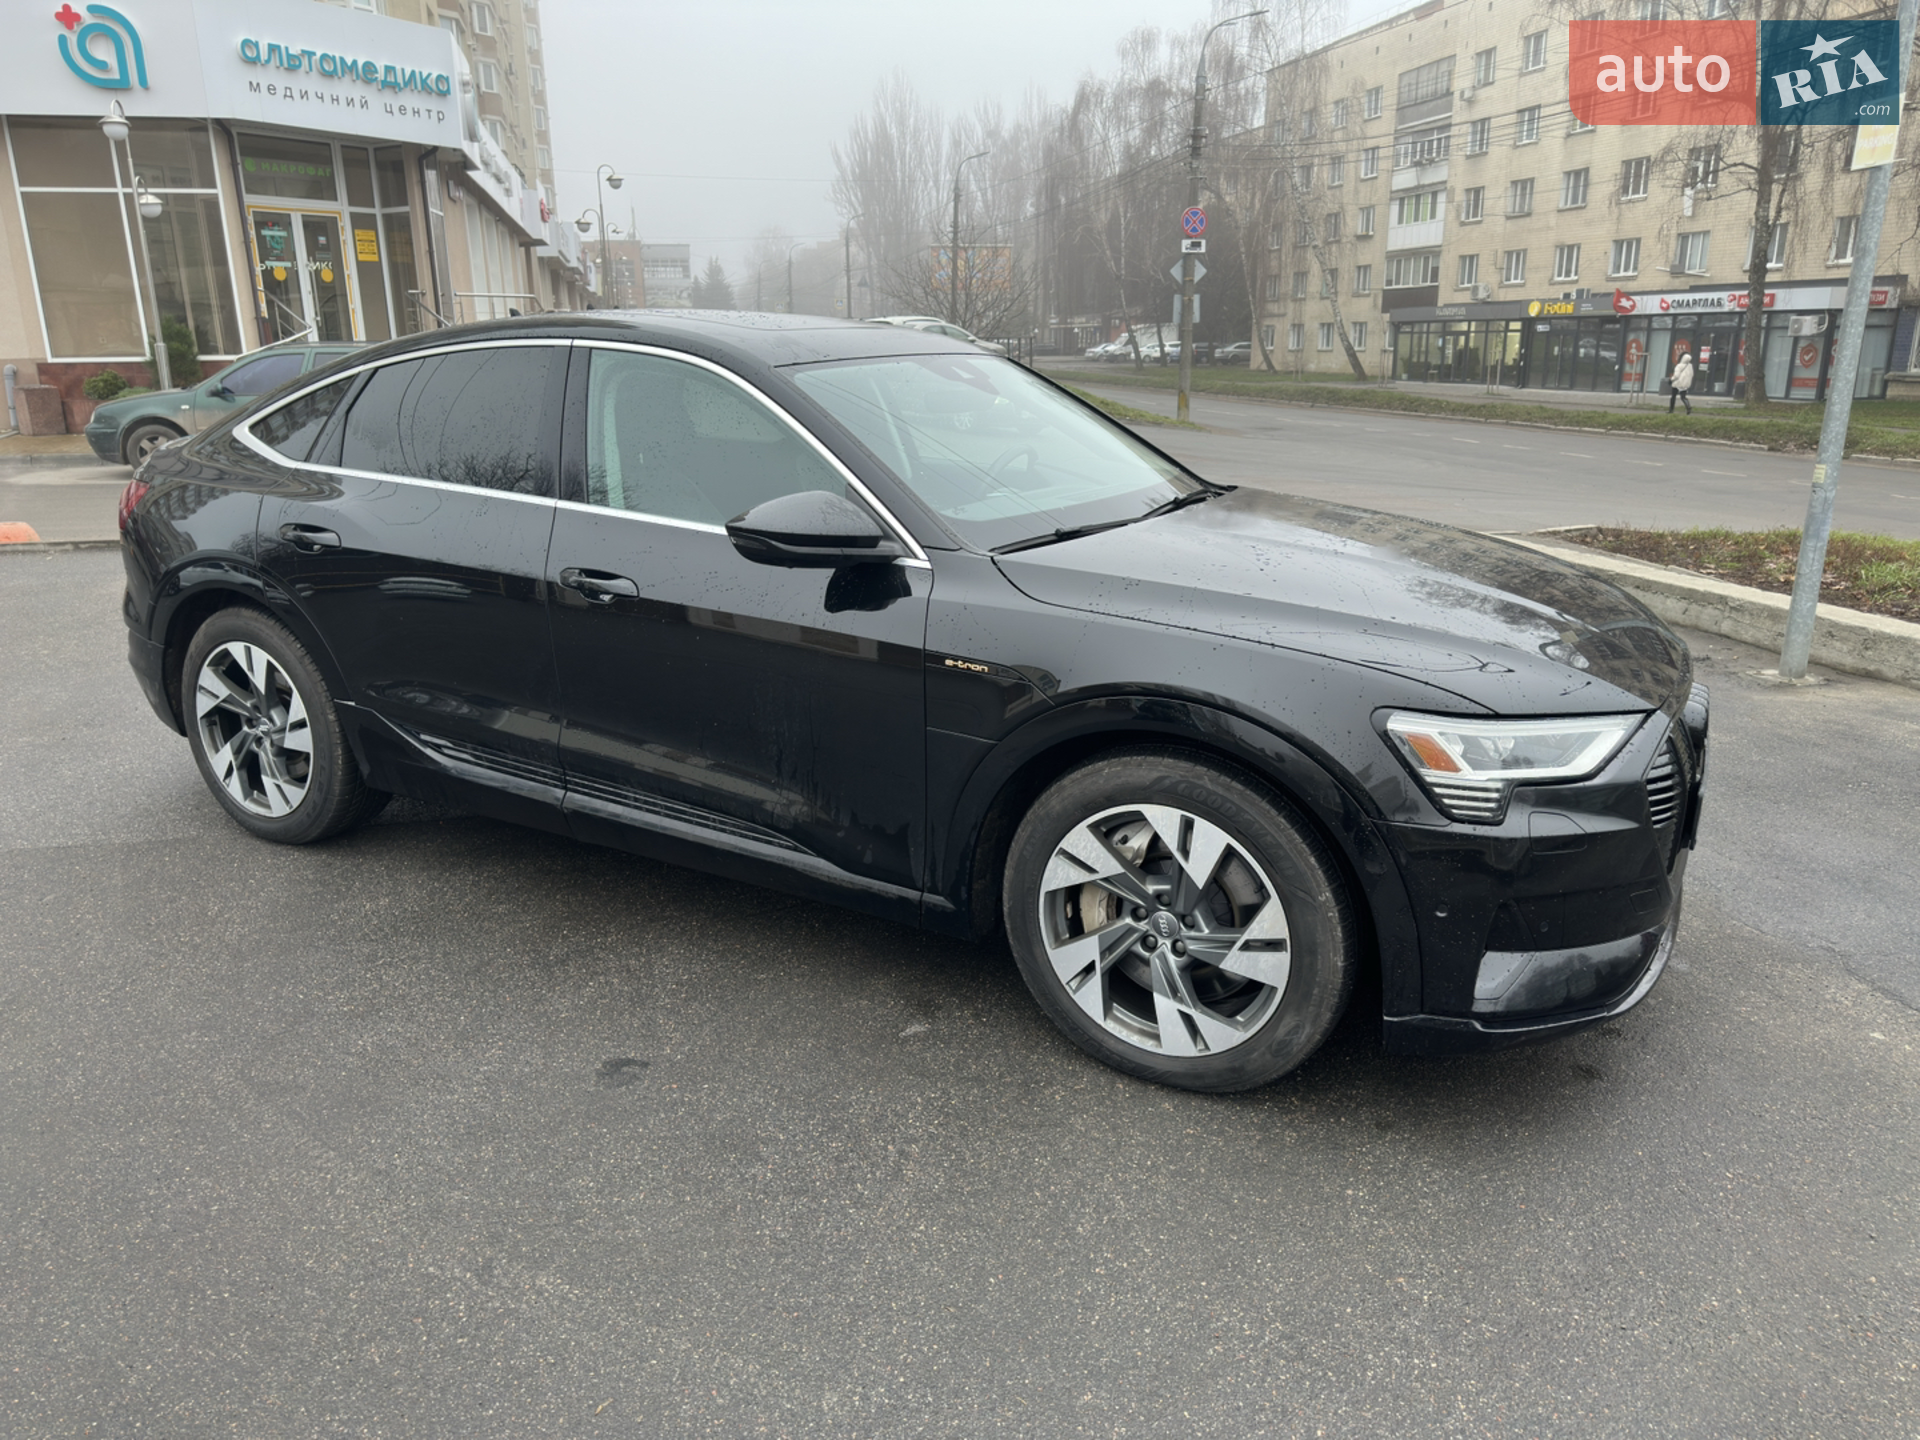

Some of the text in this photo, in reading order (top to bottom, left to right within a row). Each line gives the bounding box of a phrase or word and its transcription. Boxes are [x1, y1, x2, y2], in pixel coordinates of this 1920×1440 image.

[239, 37, 451, 96] альтамедика
[248, 80, 446, 123] медичний центр
[260, 161, 332, 177] МАКРОФАГ
[1670, 297, 1723, 310] СМАРТЛАБ
[945, 659, 989, 673] e-tron
